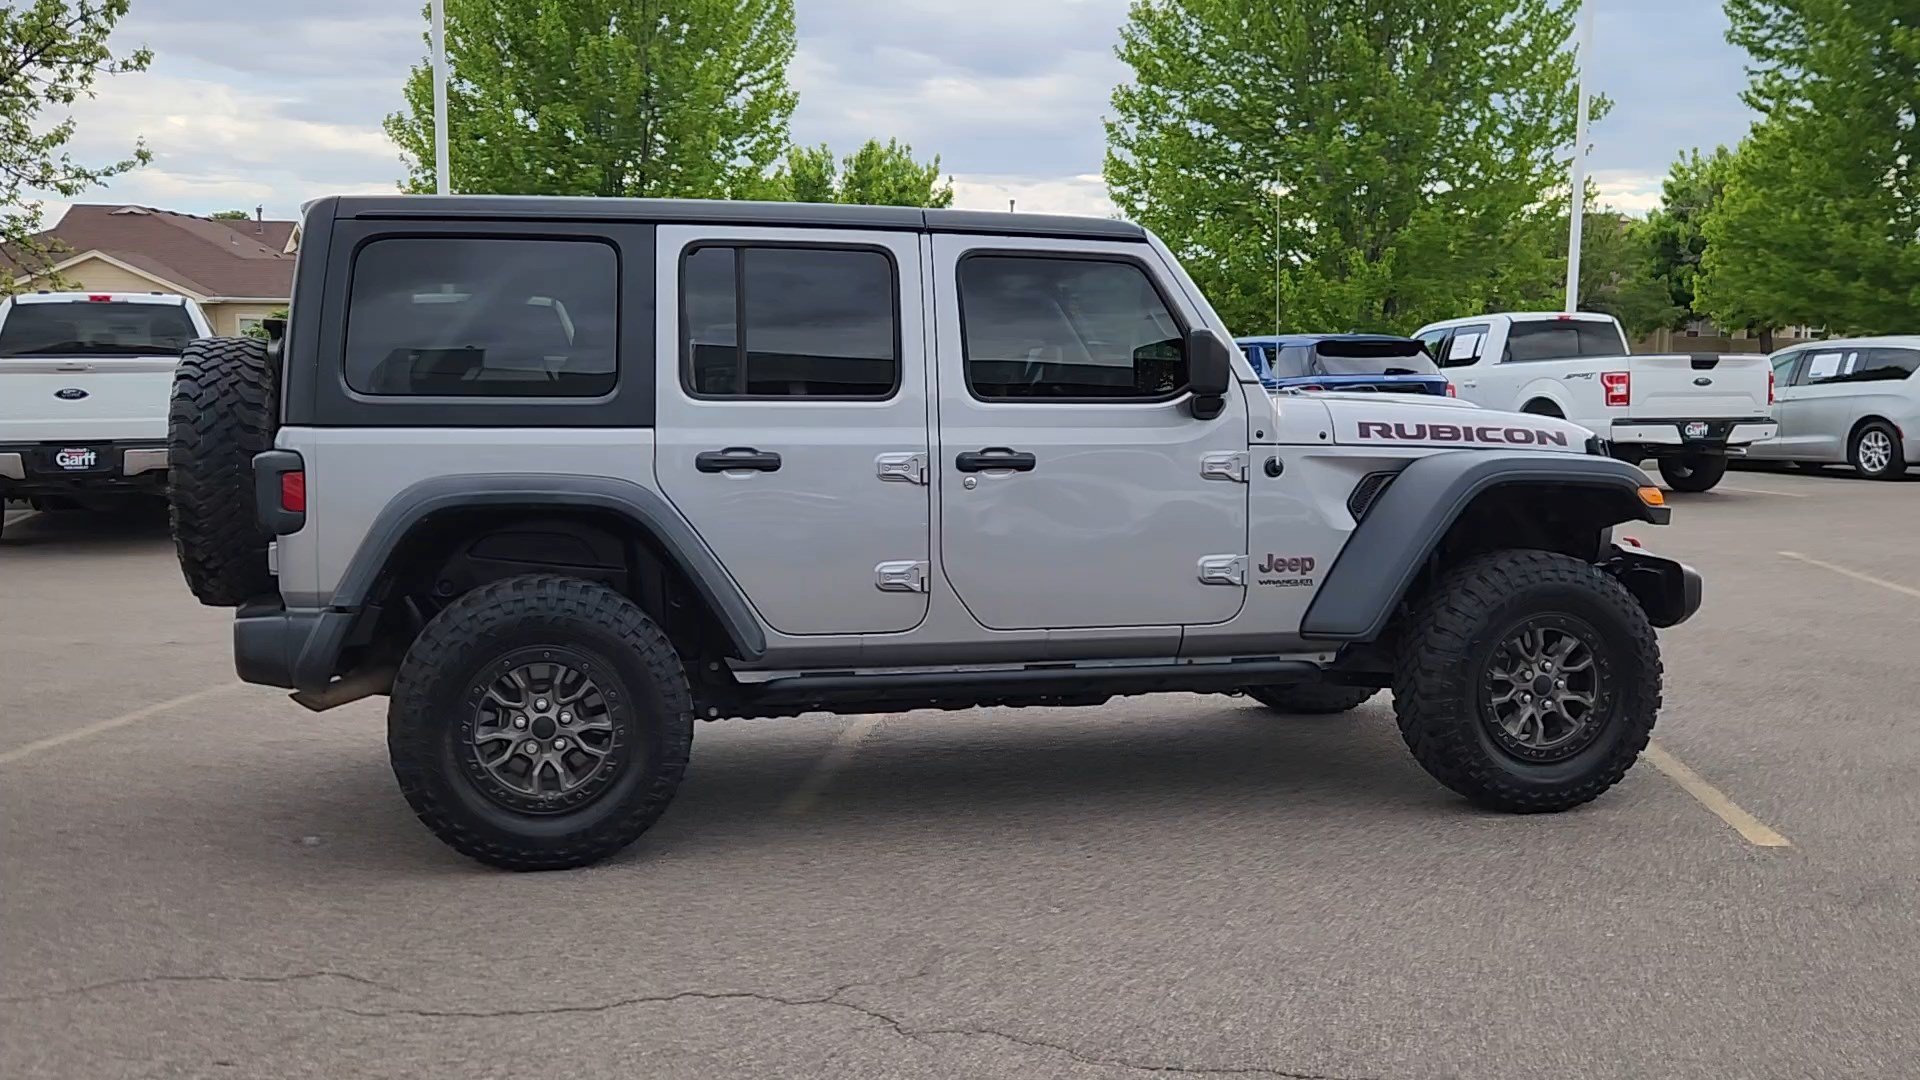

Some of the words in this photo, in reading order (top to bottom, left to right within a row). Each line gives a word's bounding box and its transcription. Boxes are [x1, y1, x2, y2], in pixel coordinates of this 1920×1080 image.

[1357, 421, 1568, 446] RUBICON
[55, 451, 96, 466] Garff
[1258, 553, 1315, 575] Jeep
